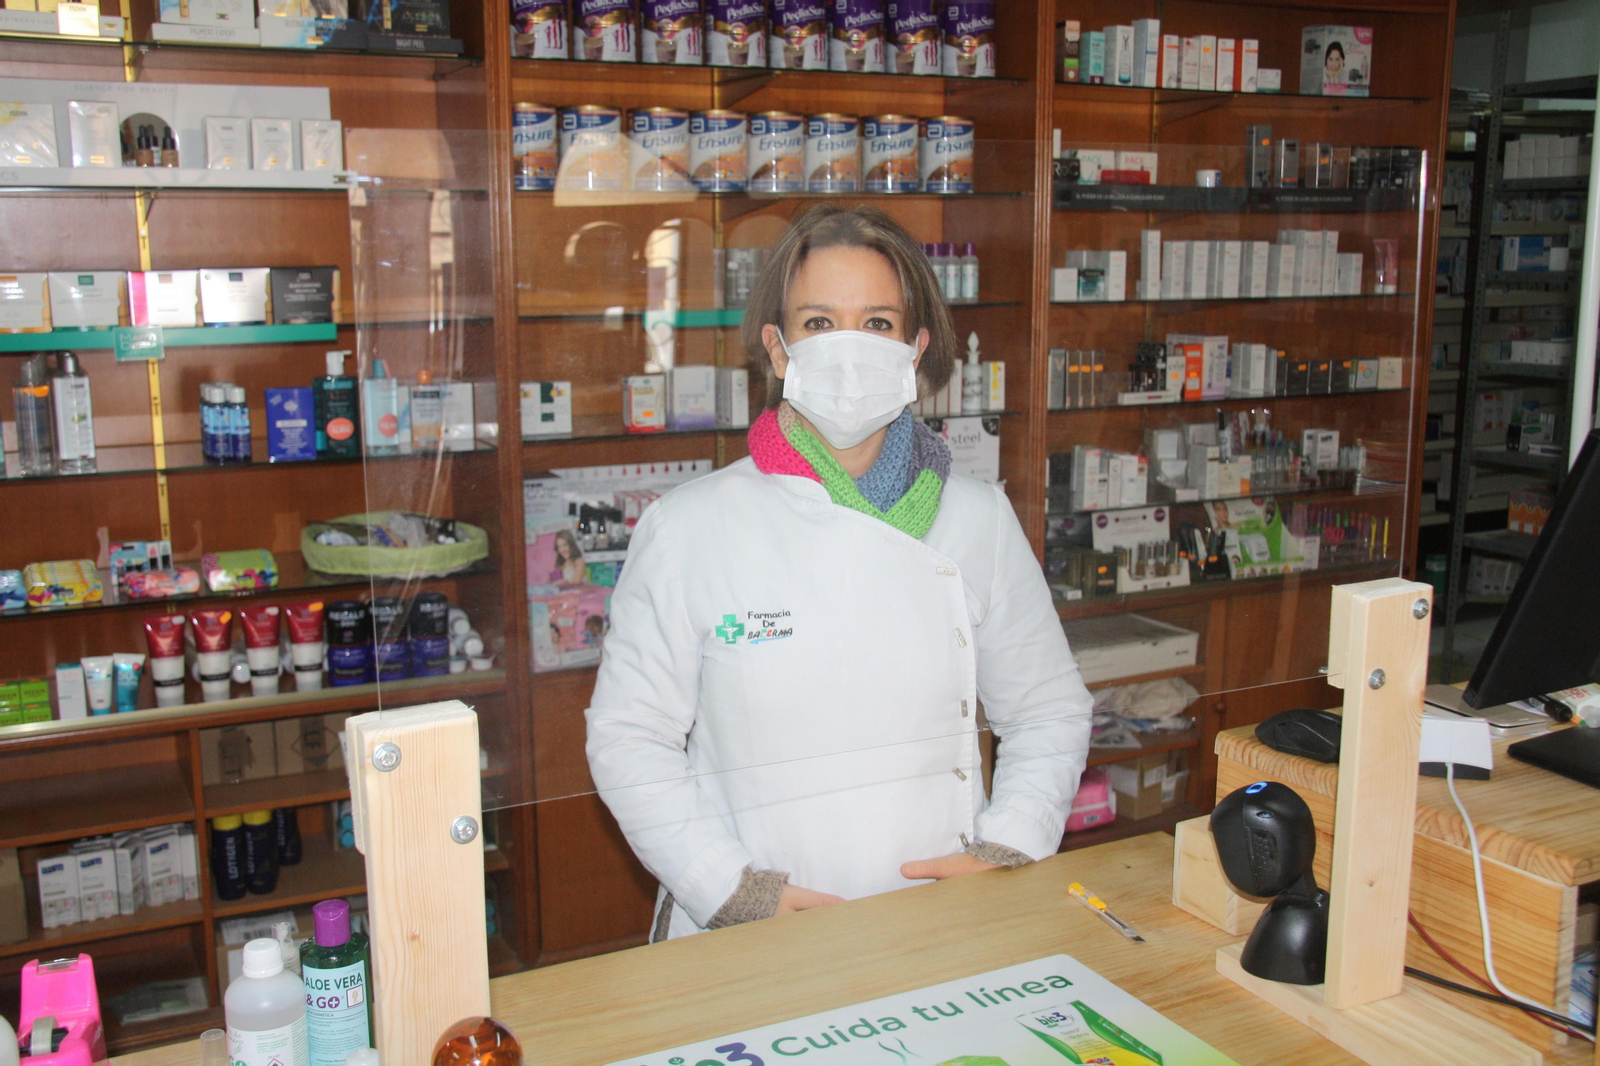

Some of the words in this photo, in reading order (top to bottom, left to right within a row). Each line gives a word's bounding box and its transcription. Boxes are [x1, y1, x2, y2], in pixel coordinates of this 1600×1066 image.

[513, 129, 553, 145] nsure
[697, 134, 743, 150] Ensure
[759, 137, 803, 151] Ensure
[870, 138, 914, 153] Ensure
[1124, 156, 1145, 166] PACK
[747, 609, 791, 620] Farmacia
[762, 620, 776, 628] De
[226, 836, 239, 881] LOTIGEN
[305, 976, 331, 991] ALOE
[334, 972, 363, 990] VERA
[306, 993, 314, 1006] &
[770, 1014, 907, 1057] Cuida
[911, 999, 964, 1022] tu
[964, 971, 1074, 1009] línea
